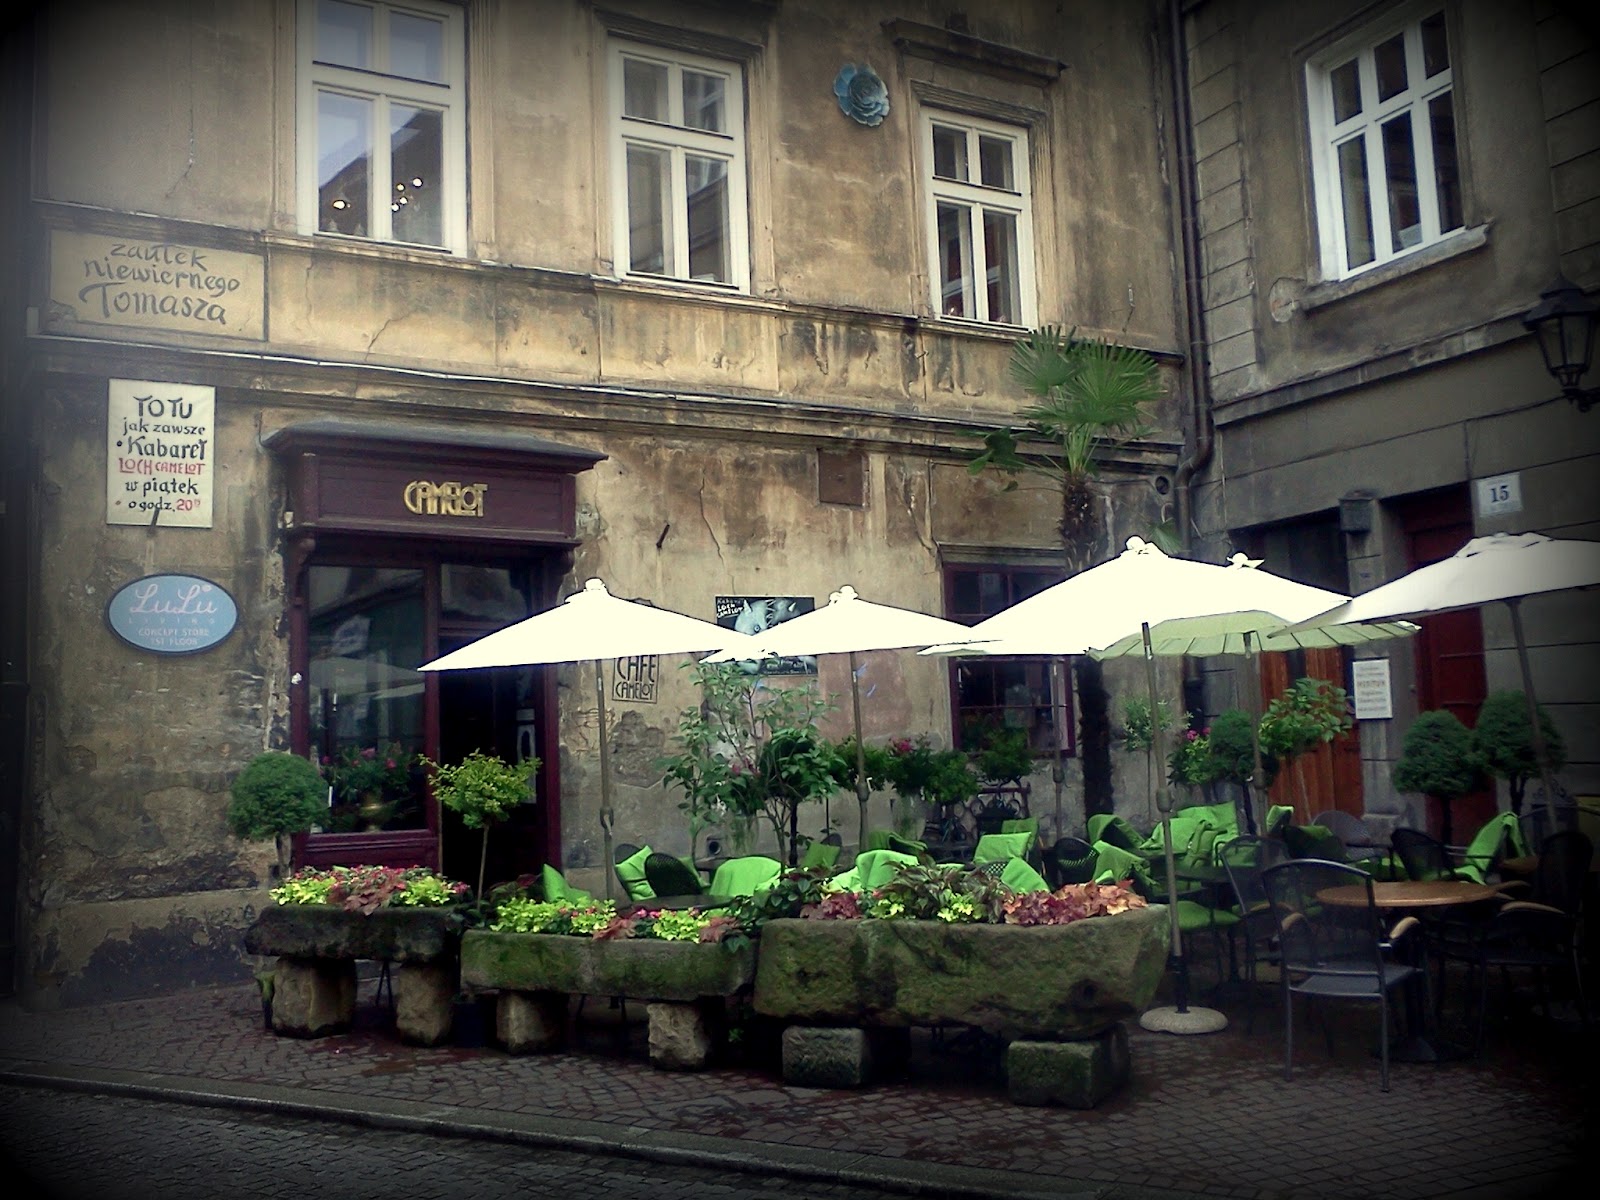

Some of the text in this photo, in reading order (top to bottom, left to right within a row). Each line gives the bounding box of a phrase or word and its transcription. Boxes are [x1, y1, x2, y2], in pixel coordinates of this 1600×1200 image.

[83, 256, 241, 298] niewiernego
[78, 281, 227, 325] Tomasza
[122, 417, 206, 436] jak zawsze
[127, 436, 208, 461] Kabaret
[118, 458, 206, 475] LOCH CAMELOT
[124, 478, 199, 497] w piątek
[1490, 484, 1509, 503] 15
[128, 501, 137, 509] o
[139, 497, 176, 512] godz.
[403, 480, 488, 517] CAMELOT
[615, 681, 655, 700] CAMELOT
